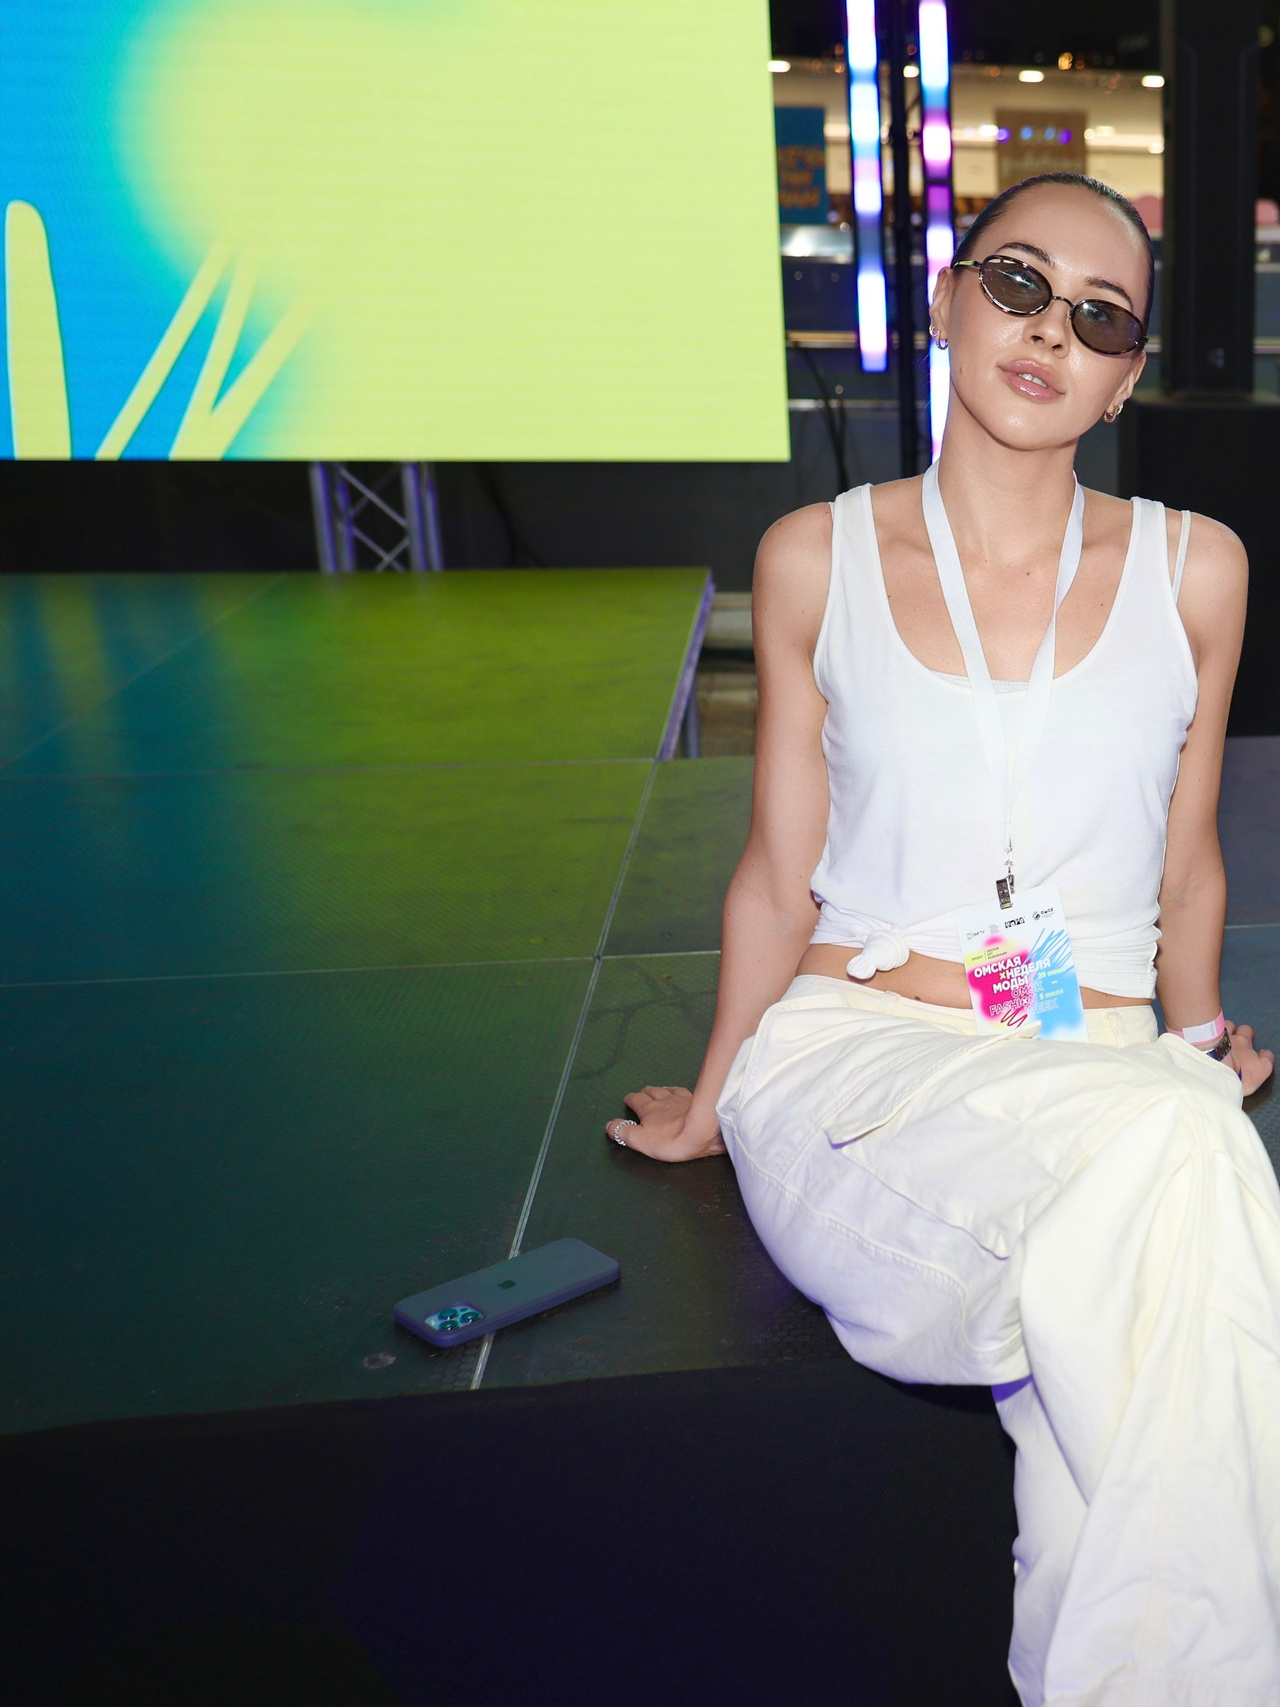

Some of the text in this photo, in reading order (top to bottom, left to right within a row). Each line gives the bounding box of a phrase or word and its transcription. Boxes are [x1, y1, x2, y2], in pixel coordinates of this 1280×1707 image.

[974, 956, 1021, 978] ОМСКАЯ
[1006, 957, 1051, 979] НЕДЕЛЯ
[993, 975, 1029, 994] МОДЫ
[1011, 981, 1044, 998] OMSK
[989, 994, 1037, 1016] FASHION
